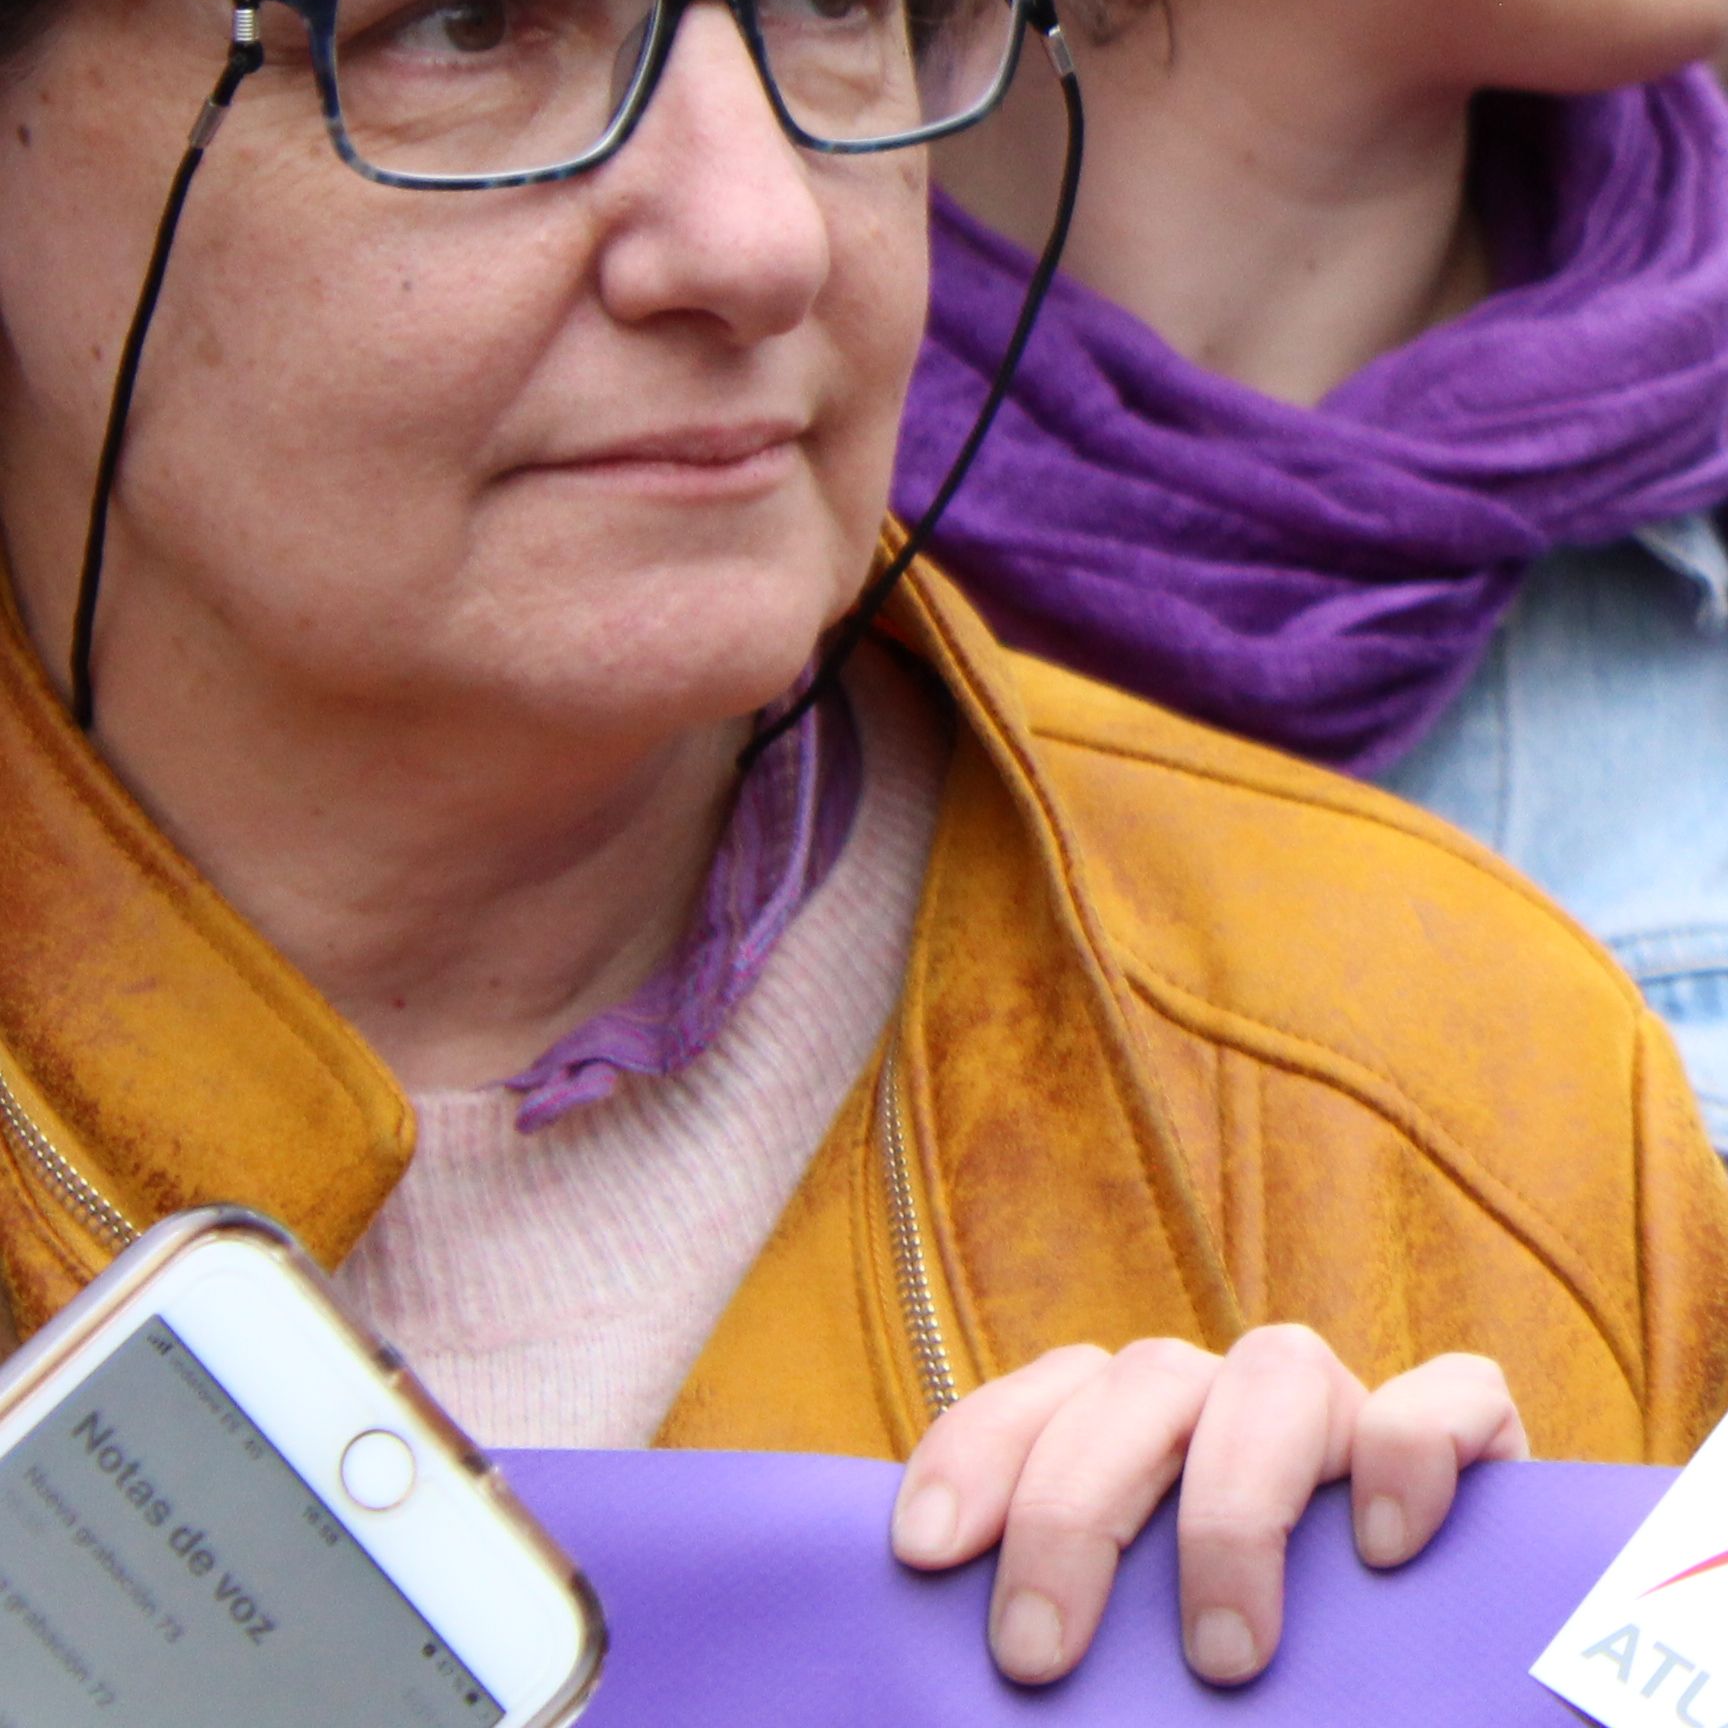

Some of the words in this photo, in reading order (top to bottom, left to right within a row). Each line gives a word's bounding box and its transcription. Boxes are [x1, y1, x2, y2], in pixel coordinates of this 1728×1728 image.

[71, 1408, 172, 1528] Notas
[168, 1522, 216, 1578] de
[212, 1571, 278, 1647] voz
